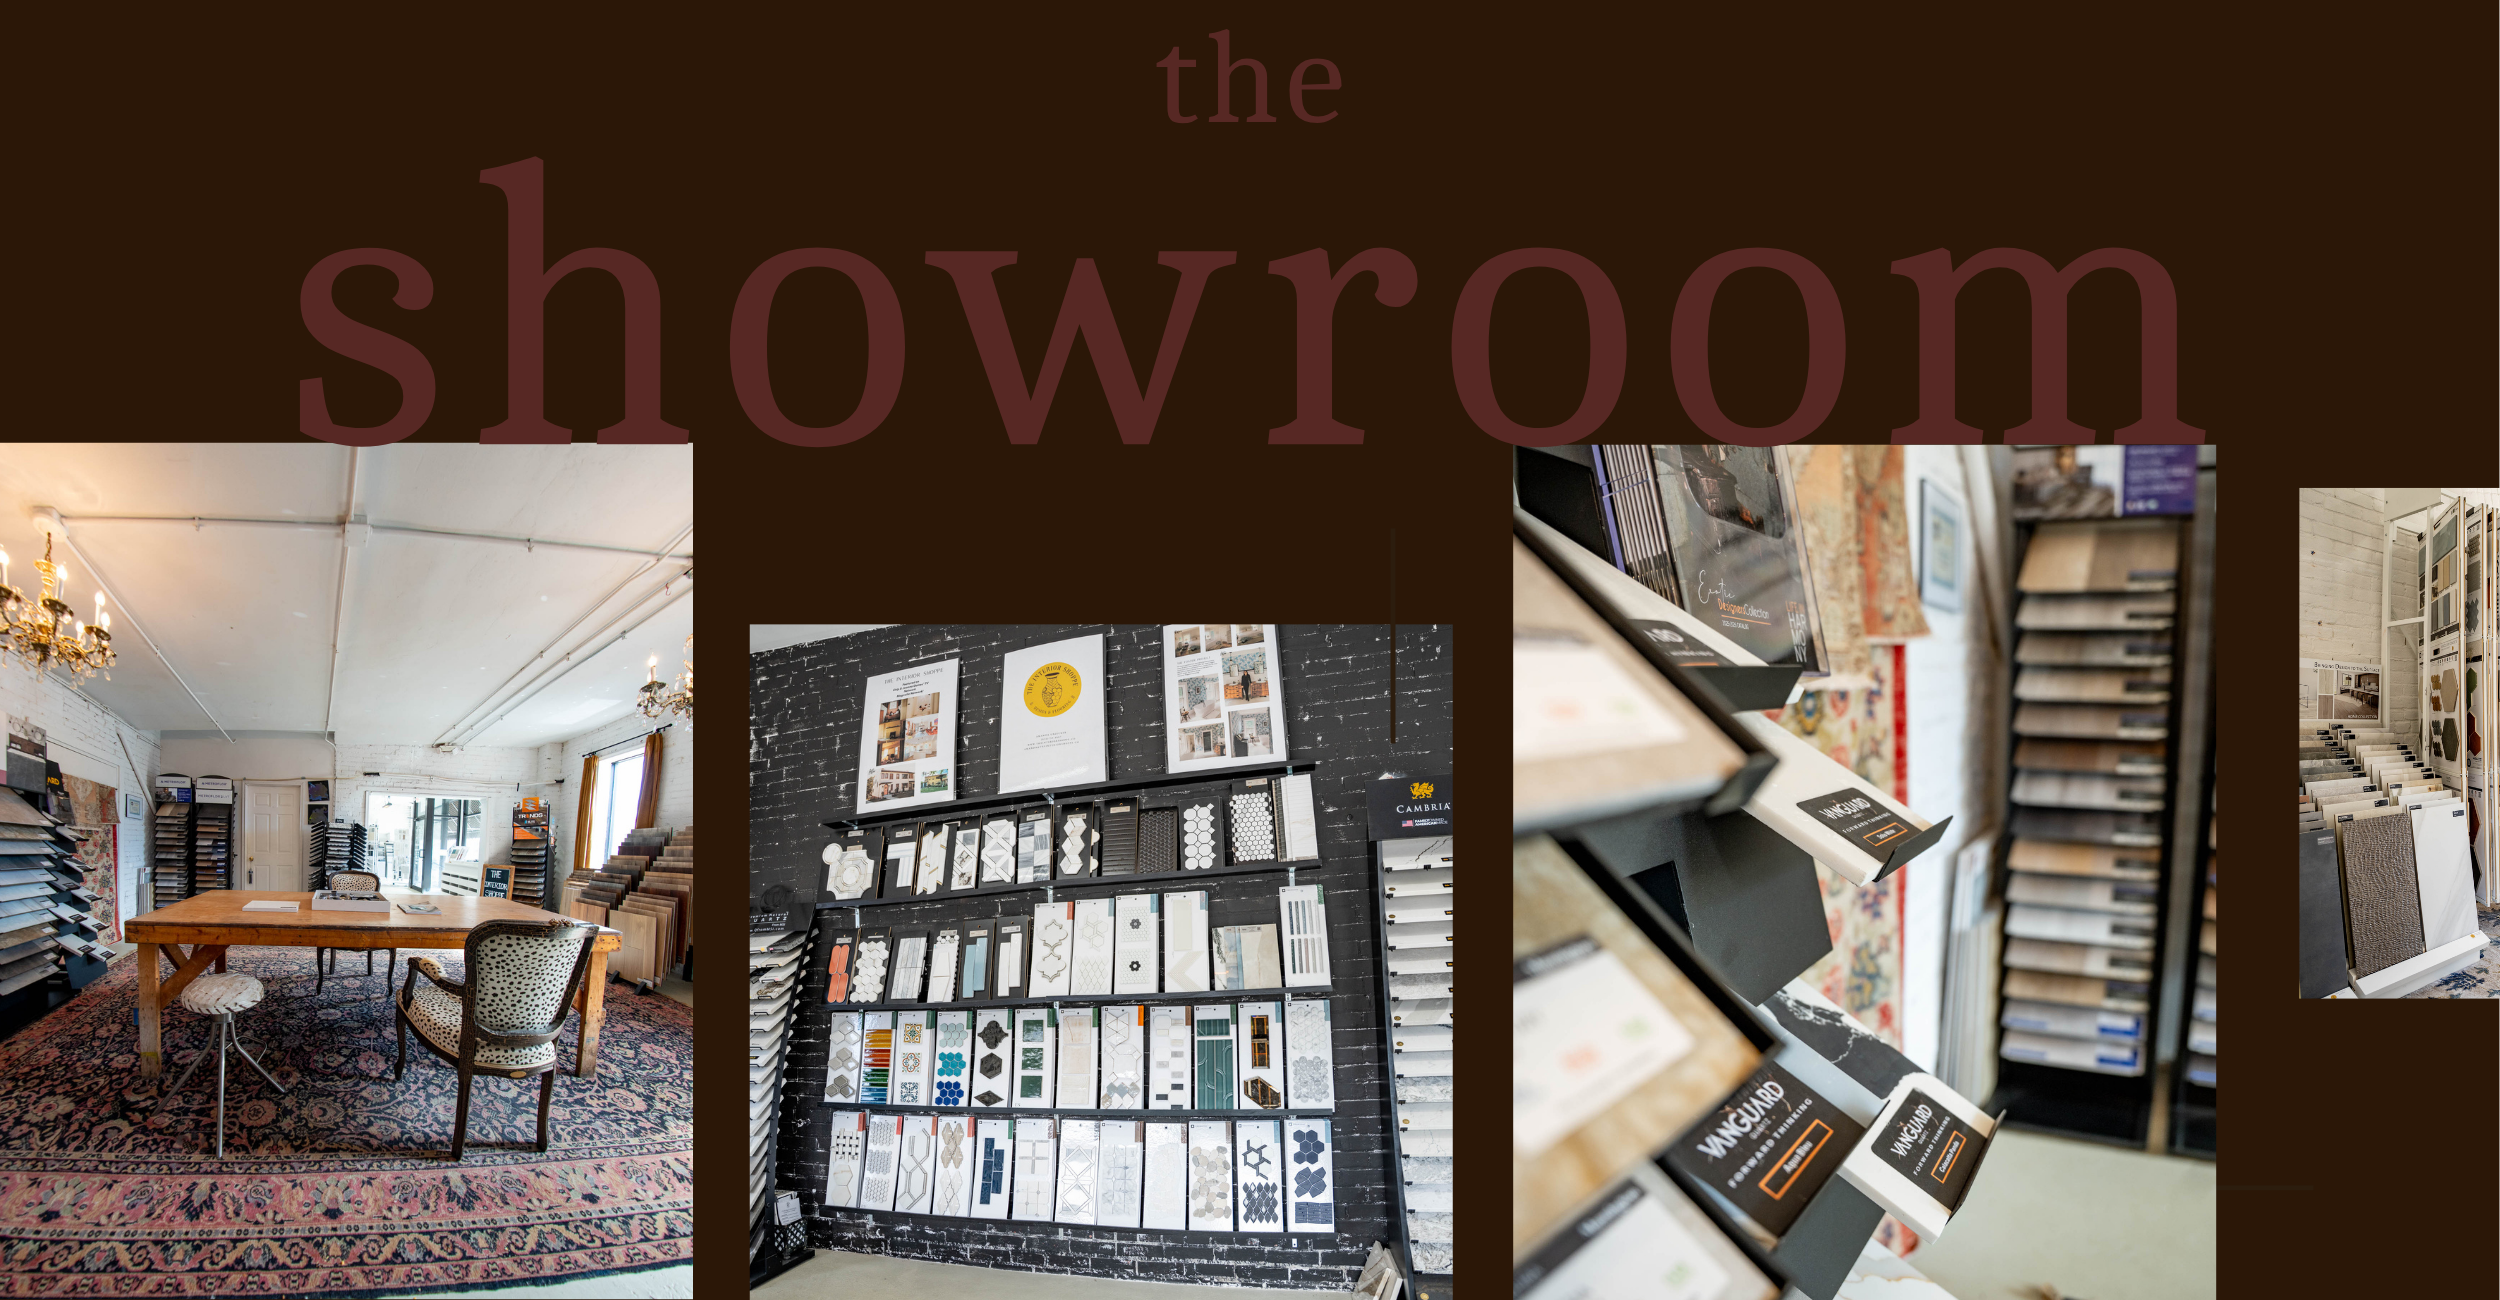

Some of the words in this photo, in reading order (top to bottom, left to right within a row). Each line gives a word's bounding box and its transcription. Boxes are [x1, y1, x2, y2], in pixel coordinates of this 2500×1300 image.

[896, 673, 920, 681] INTERIOR
[923, 668, 943, 676] SHOPPE
[1032, 665, 1061, 681] INTERIOR
[1062, 666, 1079, 686] SHOPPE
[1396, 802, 1451, 814] CAMBRIA
[1819, 797, 1871, 820] VANGUARD
[1842, 820, 1868, 834] FORWARD
[490, 870, 502, 878] THE
[484, 881, 508, 890] INTERIOR
[1696, 1081, 1784, 1159] VANGUARD
[1890, 1104, 1932, 1157] VANGUARD
[1727, 1138, 1775, 1189] FORWARD
[1772, 1098, 1813, 1139] THINKING
[1913, 1144, 1934, 1175] FORWARD
[1931, 1115, 1950, 1144] THINKING
[1948, 1140, 1960, 1155] Panda
